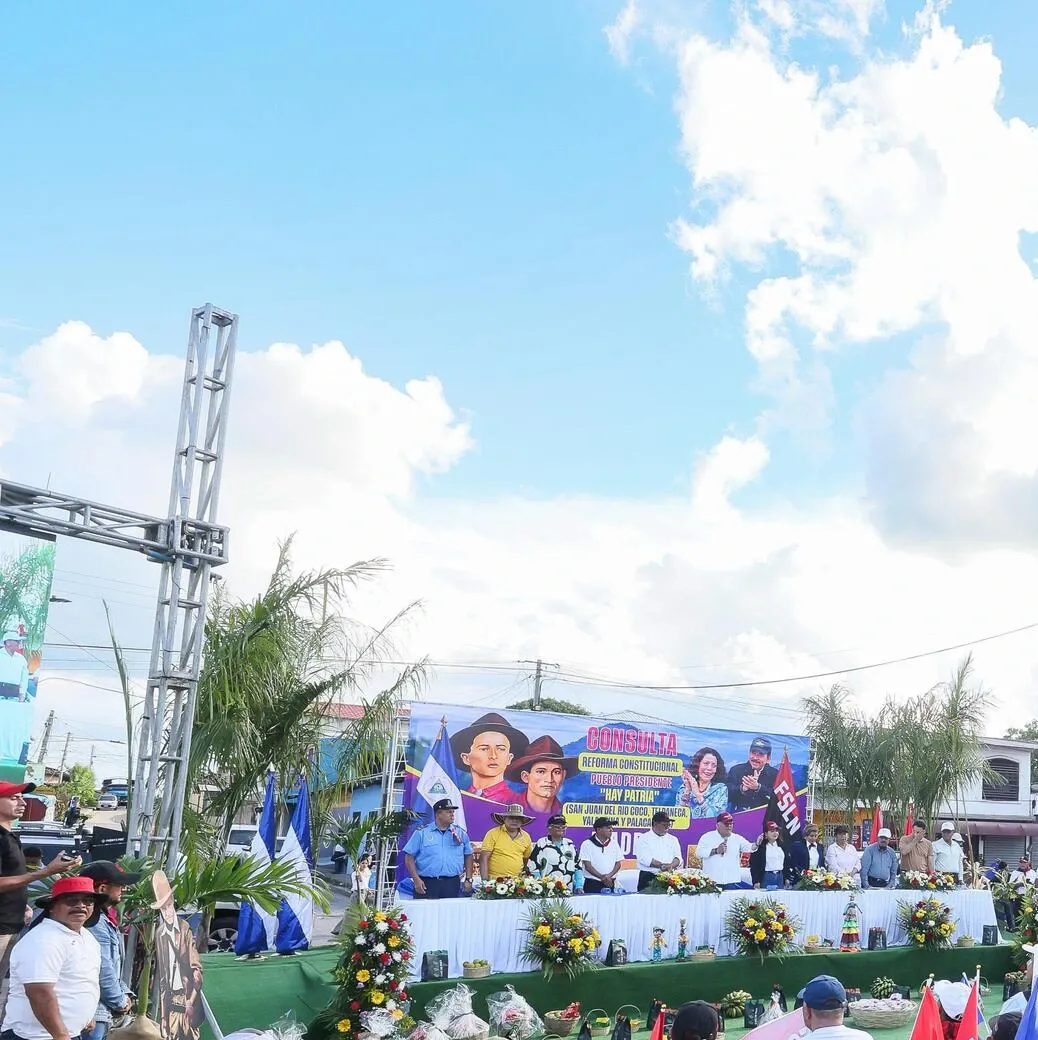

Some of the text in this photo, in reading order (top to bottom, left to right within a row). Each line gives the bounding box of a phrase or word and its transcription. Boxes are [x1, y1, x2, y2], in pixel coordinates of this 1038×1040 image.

[586, 726, 678, 756] CONSULTA
[582, 757, 680, 773] REFORMA CONSTITUCIONAL
[590, 773, 673, 789] PUEBLO PRESIDENTE
[566, 804, 583, 814] (SAN
[584, 805, 604, 815] JUAN
[604, 805, 616, 815] DEL
[774, 780, 801, 836] FSLN
[621, 817, 626, 827] Y
